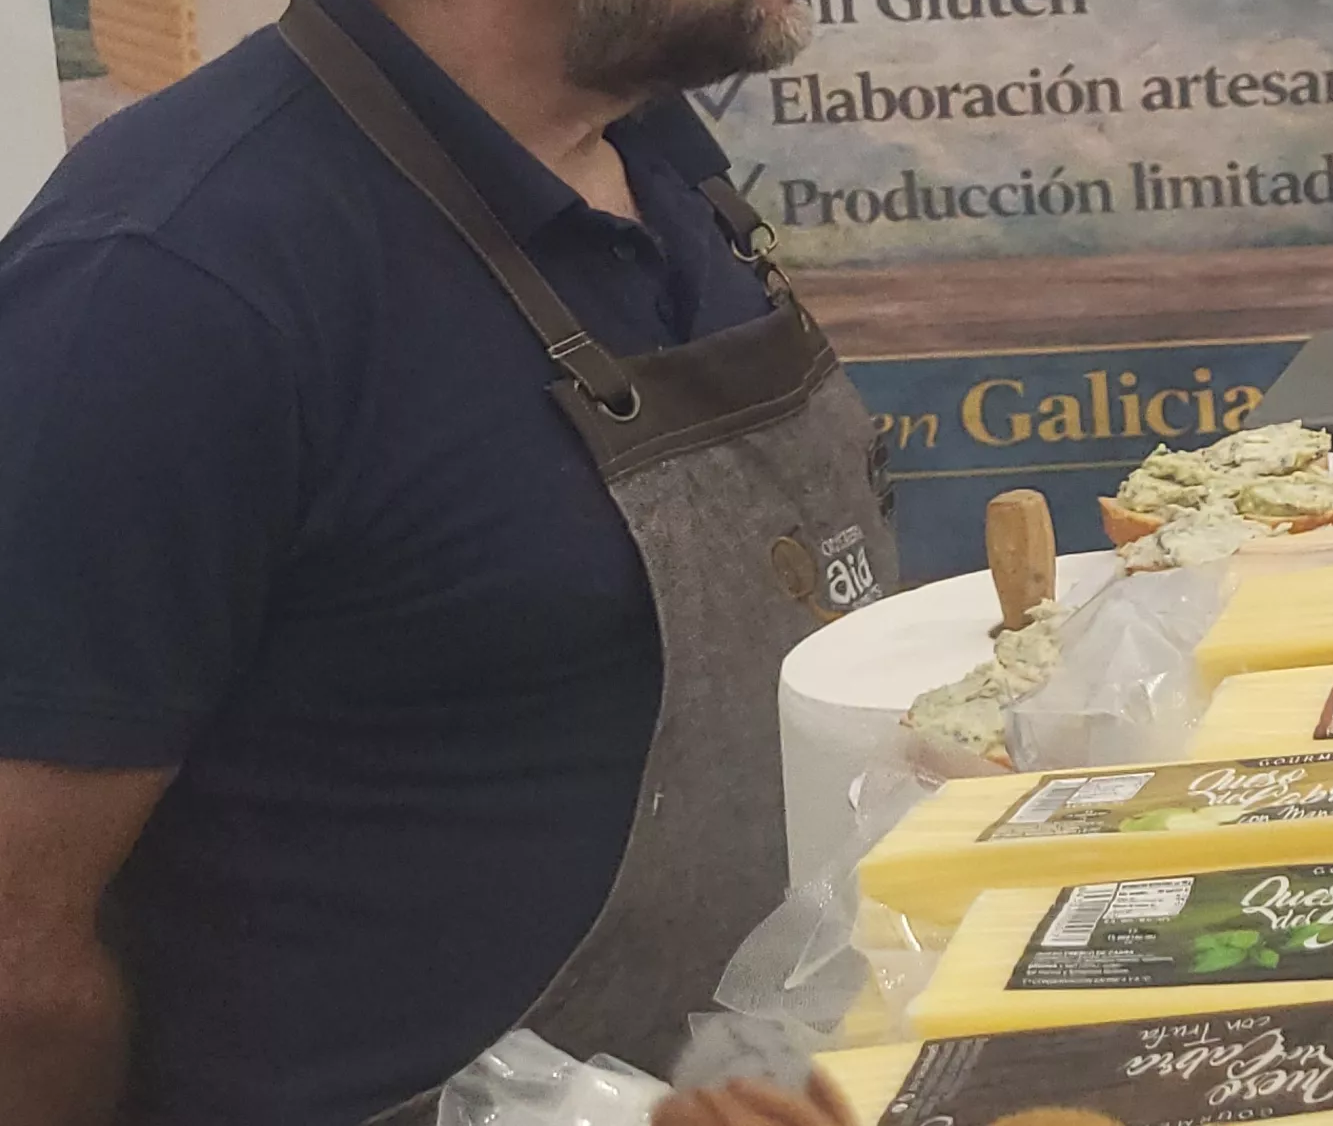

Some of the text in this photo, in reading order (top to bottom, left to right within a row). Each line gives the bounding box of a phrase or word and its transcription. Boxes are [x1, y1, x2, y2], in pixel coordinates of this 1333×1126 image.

[770, 63, 1122, 126] Elaboración
[780, 165, 1115, 227] Producción
[961, 367, 1266, 448] Galicia
[1188, 768, 1309, 805] Queso
[1122, 1028, 1285, 1080] Cabra
[1138, 1021, 1221, 1050] Trufa
